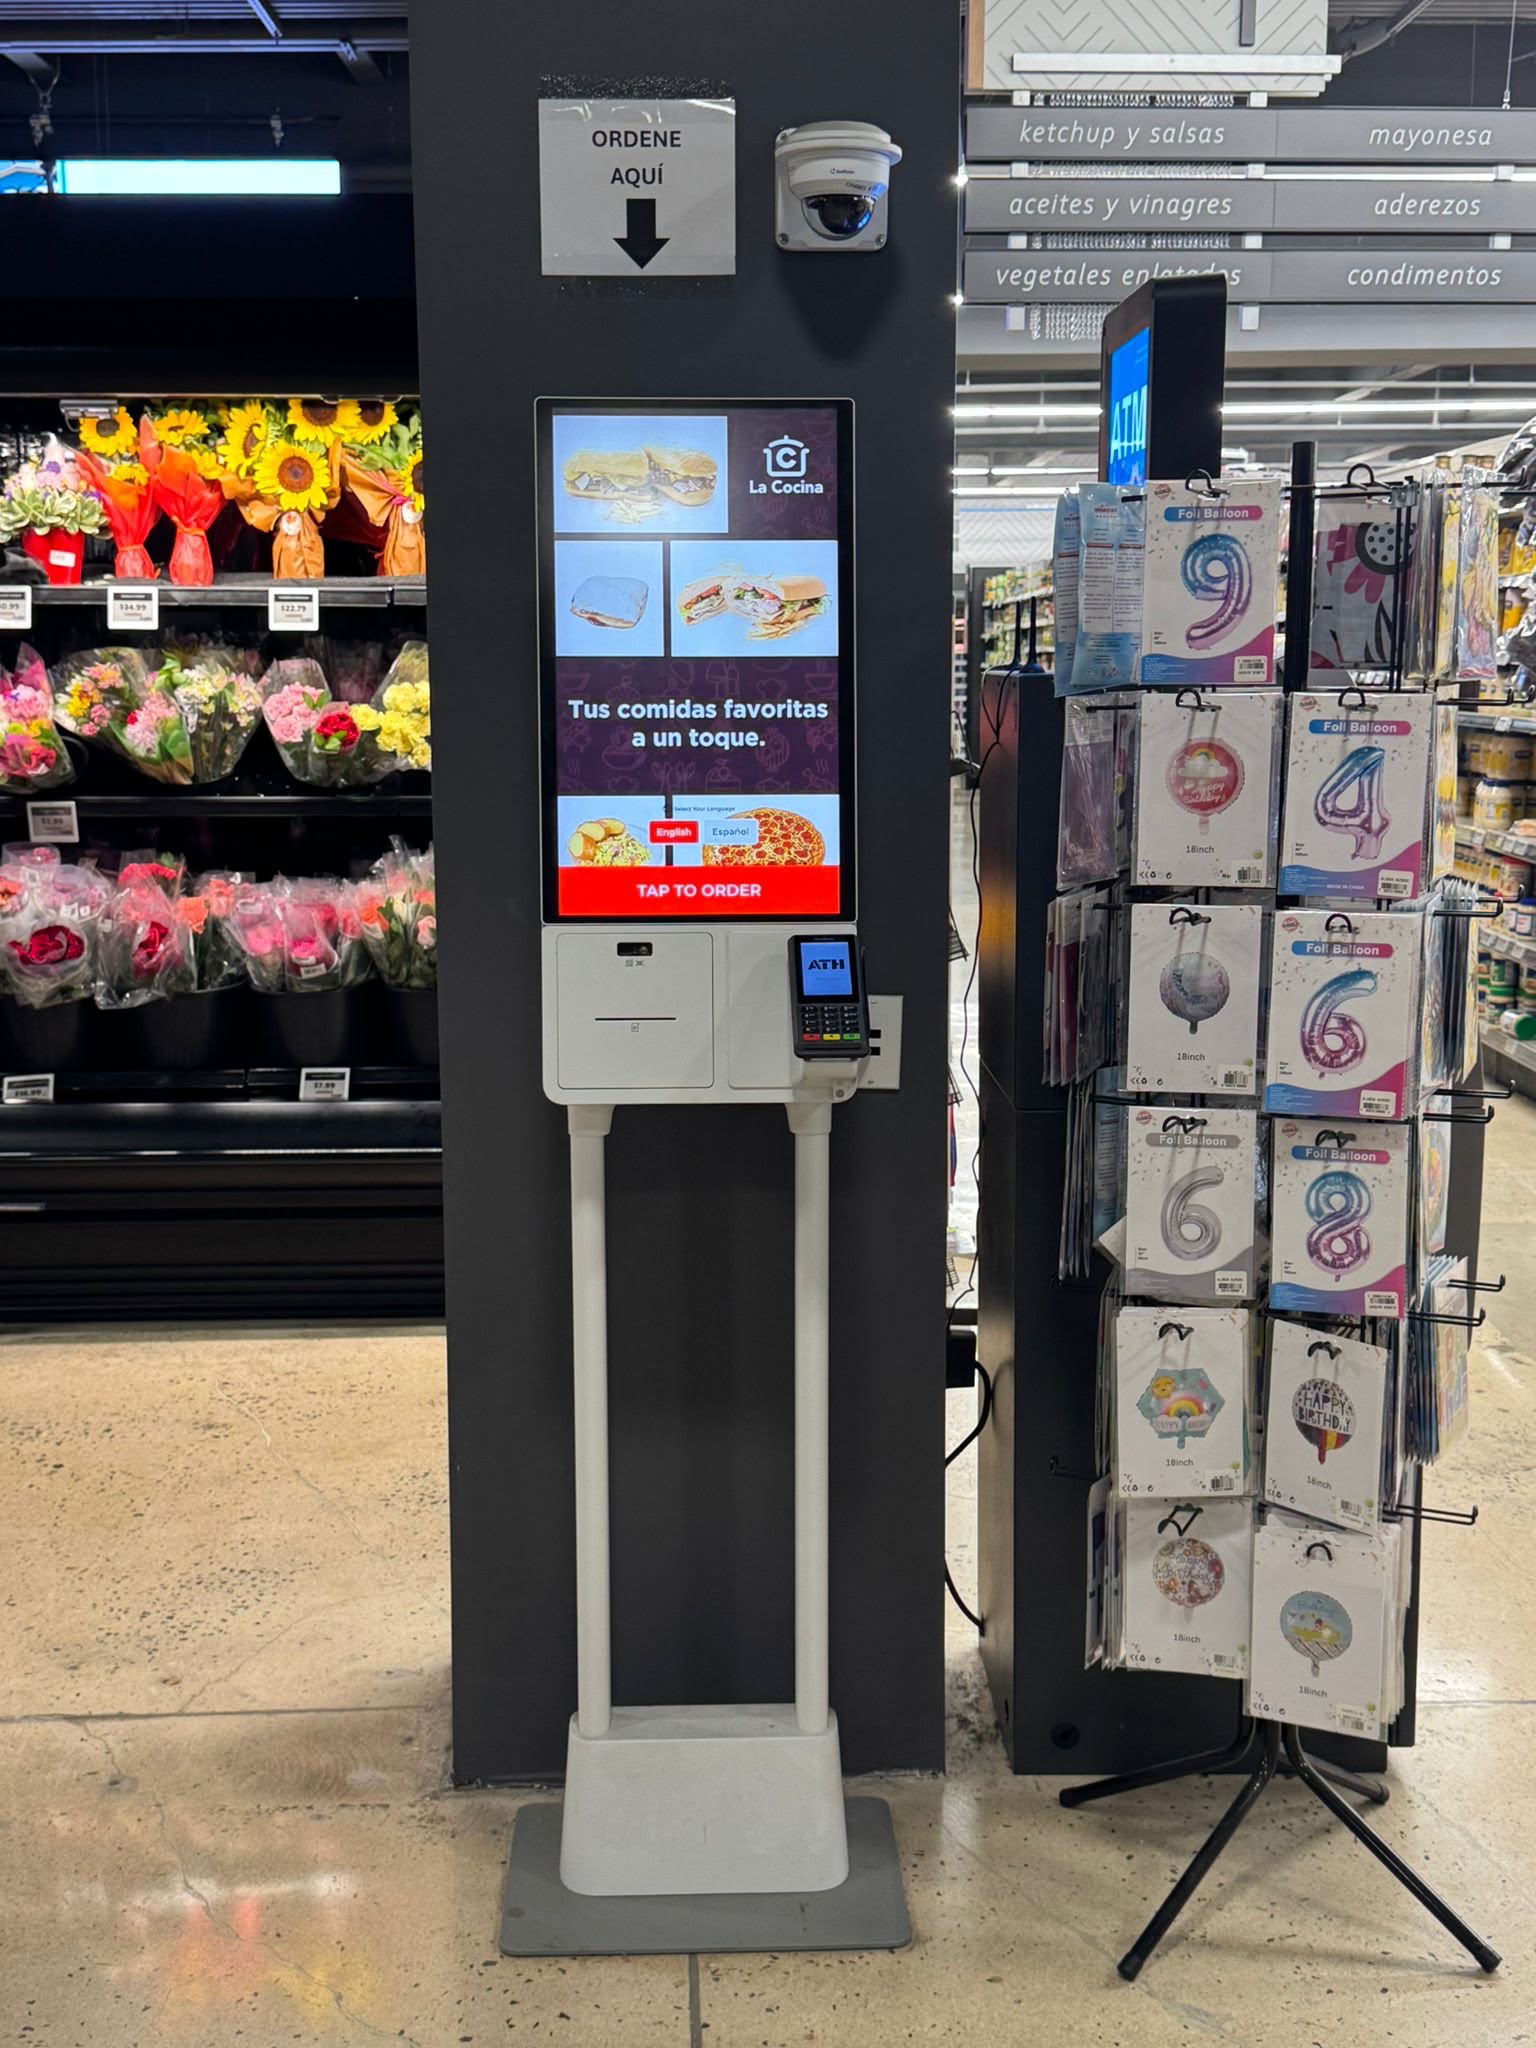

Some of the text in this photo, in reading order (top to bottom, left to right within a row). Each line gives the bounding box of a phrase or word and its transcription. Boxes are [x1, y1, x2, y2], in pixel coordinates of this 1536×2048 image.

[592, 130, 681, 148] ORDENE
[1019, 119, 1225, 149] ketchup y salsas
[1368, 126, 1492, 152] mayonesa
[610, 163, 663, 187] AQUÍ
[1009, 193, 1232, 221] aceites y vinagres
[1373, 196, 1481, 216] aderezos
[996, 265, 1111, 293] vegetales
[1347, 265, 1502, 287] condimentos
[1110, 385, 1148, 464] ATM
[750, 480, 823, 494] La Cocina
[1178, 508, 1249, 520] Foil Balloon
[120, 603, 147, 612] $34.99
[568, 698, 829, 719] Tus comidas favoritas
[1323, 721, 1397, 734] Foil Balloon
[631, 729, 766, 751] a un toque.
[706, 806, 735, 814] Language
[655, 826, 692, 838] English
[712, 826, 749, 839] Español
[1186, 844, 1214, 854] 18inch
[637, 884, 762, 897] TAP TO ORDER
[1306, 942, 1379, 956] Foil Balloon
[808, 959, 845, 970] ATH
[1177, 1053, 1205, 1062] 18inch
[1159, 1134, 1227, 1146] Foil Balloon
[1305, 1148, 1376, 1161] Foil Balloon
[1303, 1391, 1346, 1416] HAPPY
[1165, 1458, 1194, 1467] 18inch
[1307, 1475, 1332, 1490] 18inch
[1173, 1634, 1201, 1644] 18inch
[1299, 1685, 1328, 1698] 18inch
